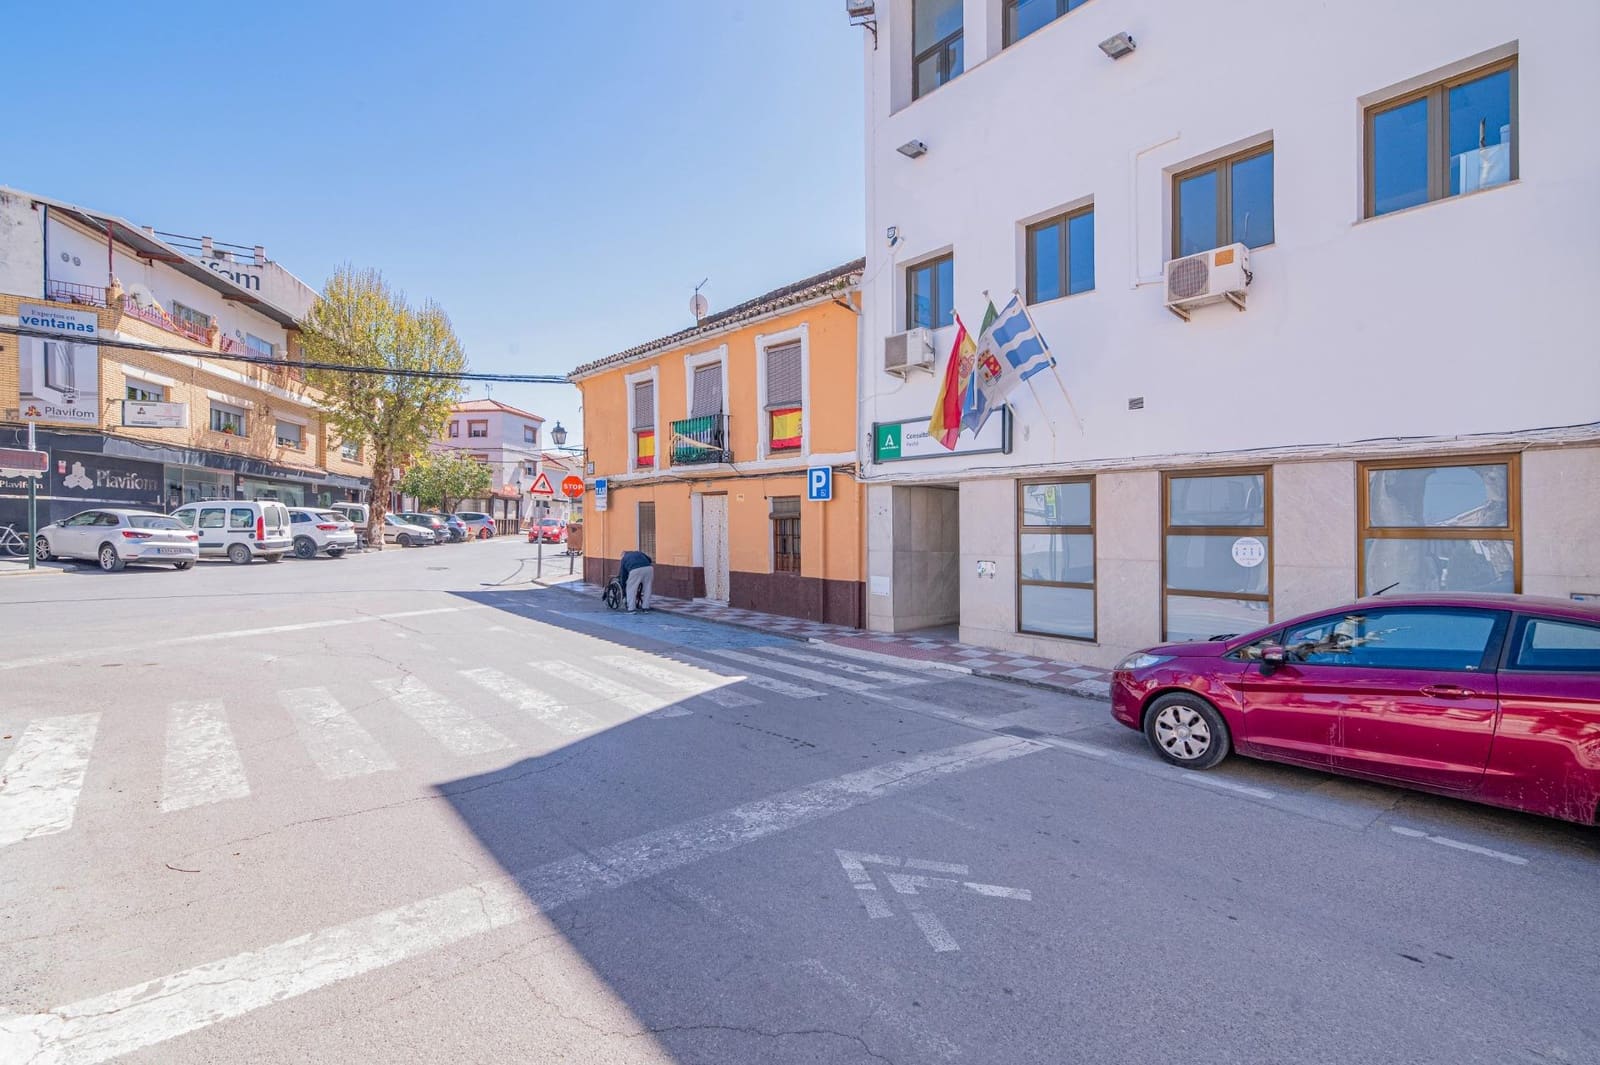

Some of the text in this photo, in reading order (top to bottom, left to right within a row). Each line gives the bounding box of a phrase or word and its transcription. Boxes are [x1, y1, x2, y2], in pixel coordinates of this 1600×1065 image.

[21, 316, 95, 333] ventanas
[44, 406, 95, 418] Plavifom
[0, 480, 44, 489] Plavifm
[96, 469, 158, 490] Plavifom
[812, 470, 826, 497] P
